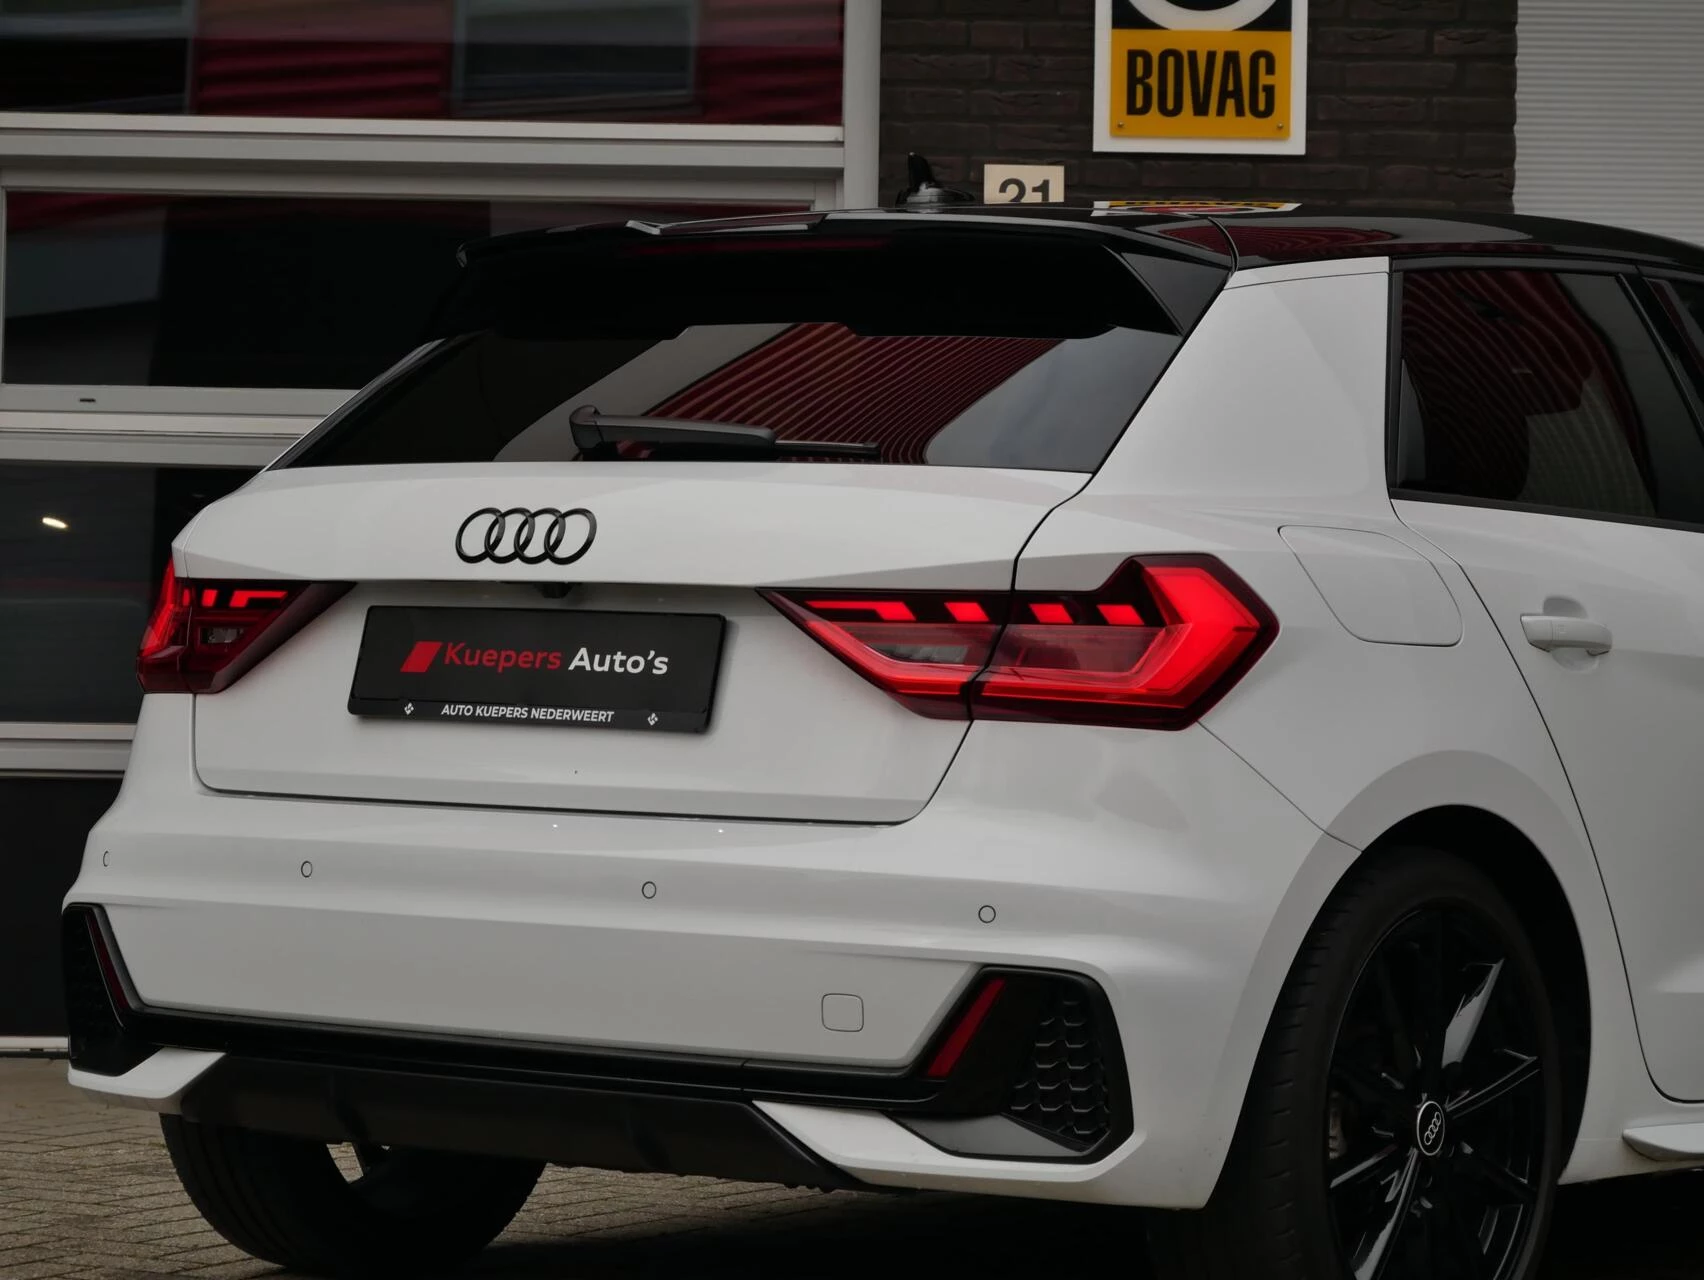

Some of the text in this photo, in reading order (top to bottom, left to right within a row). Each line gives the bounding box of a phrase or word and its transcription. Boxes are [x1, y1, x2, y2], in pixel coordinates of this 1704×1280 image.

[1126, 48, 1276, 119] BOVAG
[998, 178, 1050, 202] 21
[443, 642, 669, 675] Kuepers Auto's
[441, 704, 615, 722] AUTO KUEPERS NEDERWEERT
